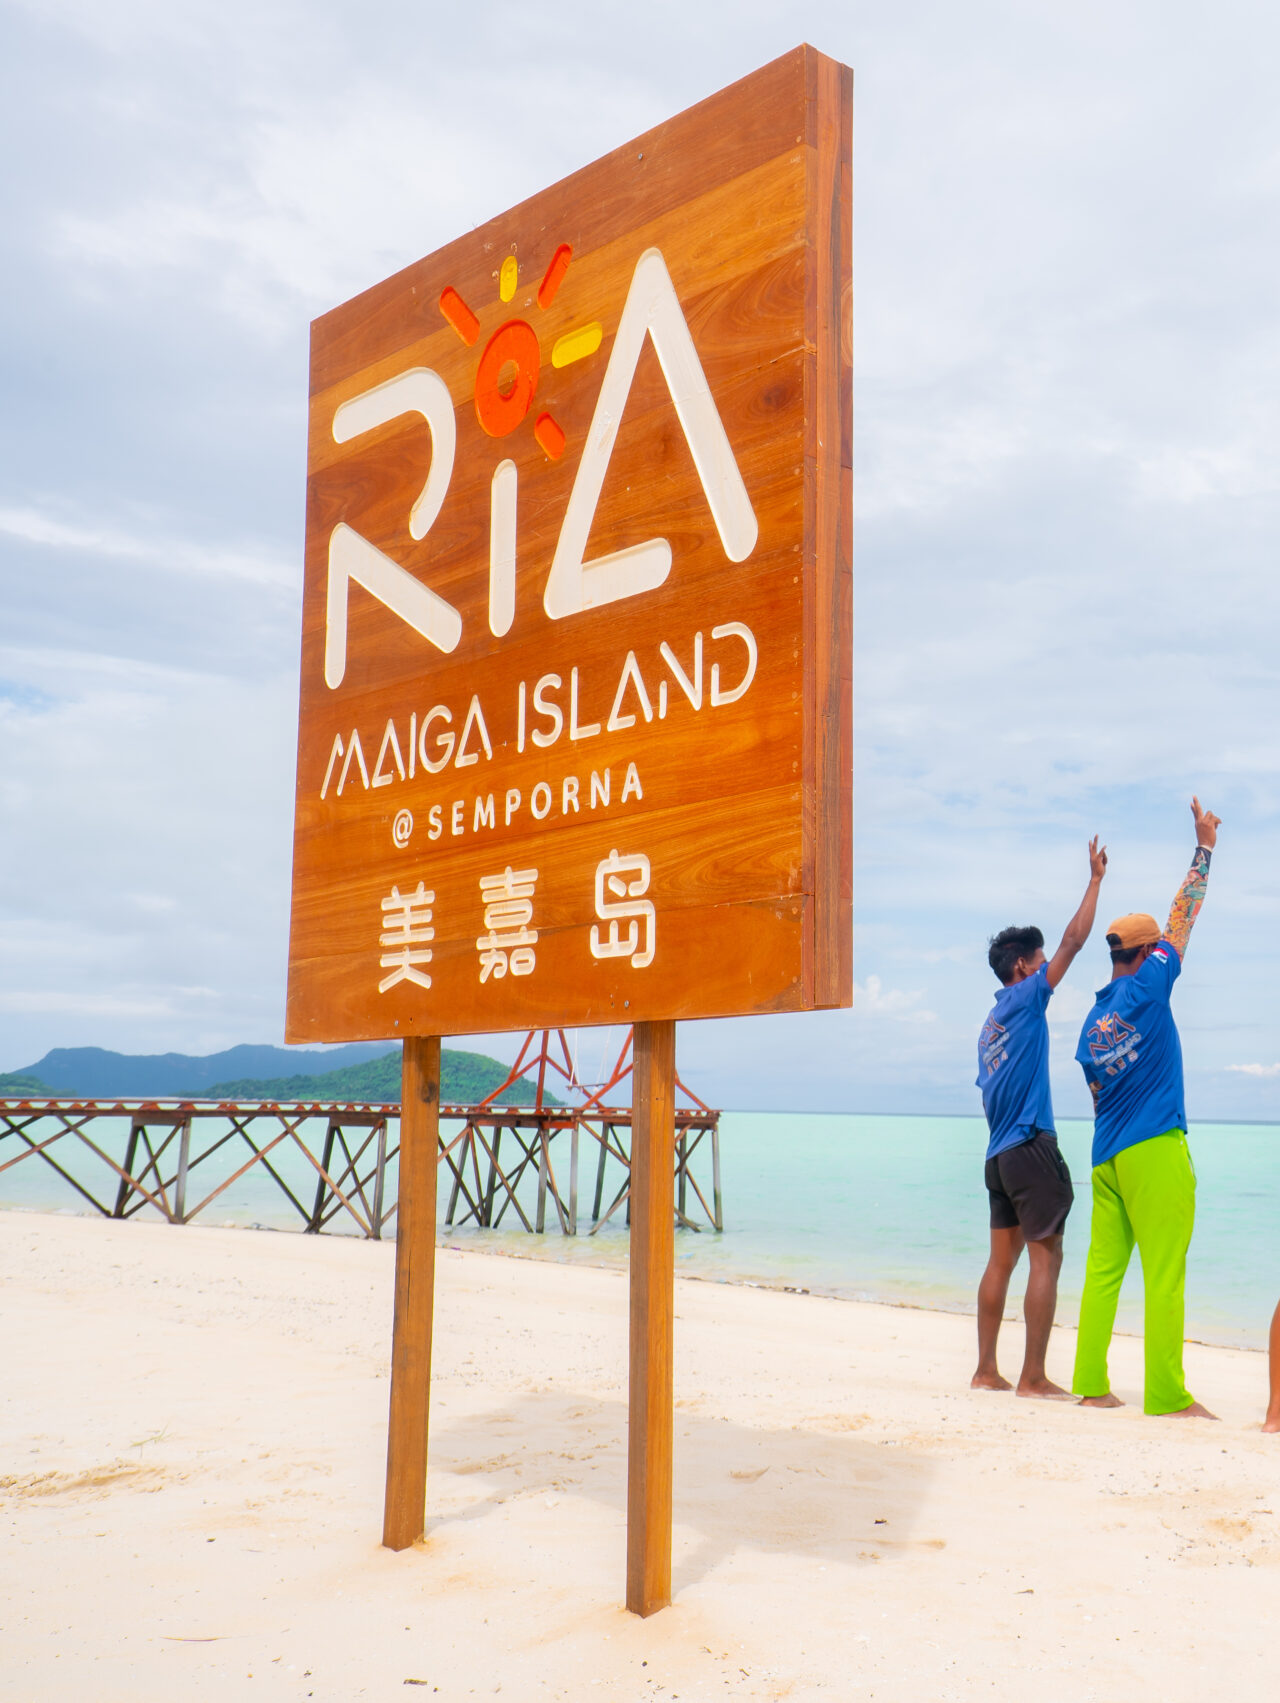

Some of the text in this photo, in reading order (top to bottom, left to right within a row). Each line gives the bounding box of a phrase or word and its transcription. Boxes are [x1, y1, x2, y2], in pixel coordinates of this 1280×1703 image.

[320, 621, 758, 800] MAIGA ISLAND
[392, 762, 643, 849] @ SEMPORNA
[378, 849, 656, 994] 美嘉岛
